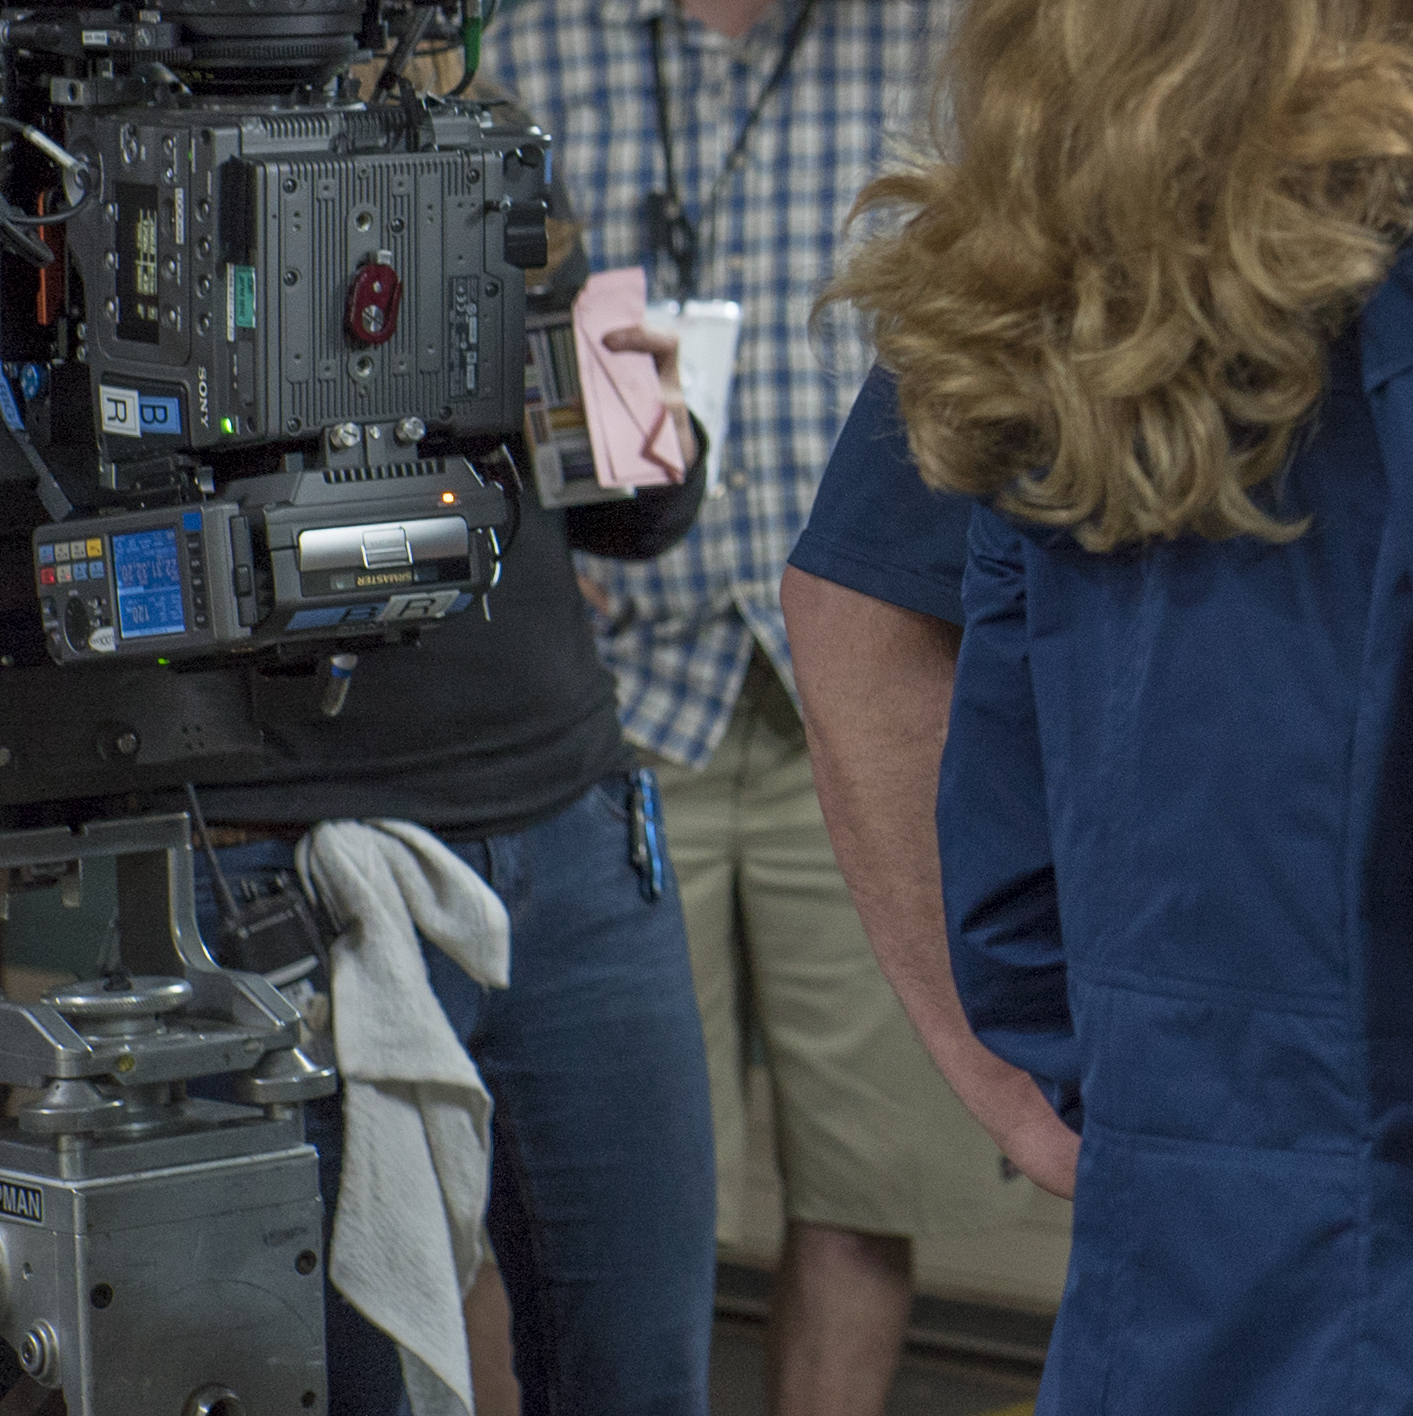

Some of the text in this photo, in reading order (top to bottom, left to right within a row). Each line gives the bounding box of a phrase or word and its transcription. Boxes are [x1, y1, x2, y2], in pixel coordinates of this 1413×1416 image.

[106, 396, 127, 423] R
[198, 366, 209, 429] SONY
[140, 404, 168, 424] B
[398, 597, 437, 618] R
[0, 1184, 40, 1219] MAN
